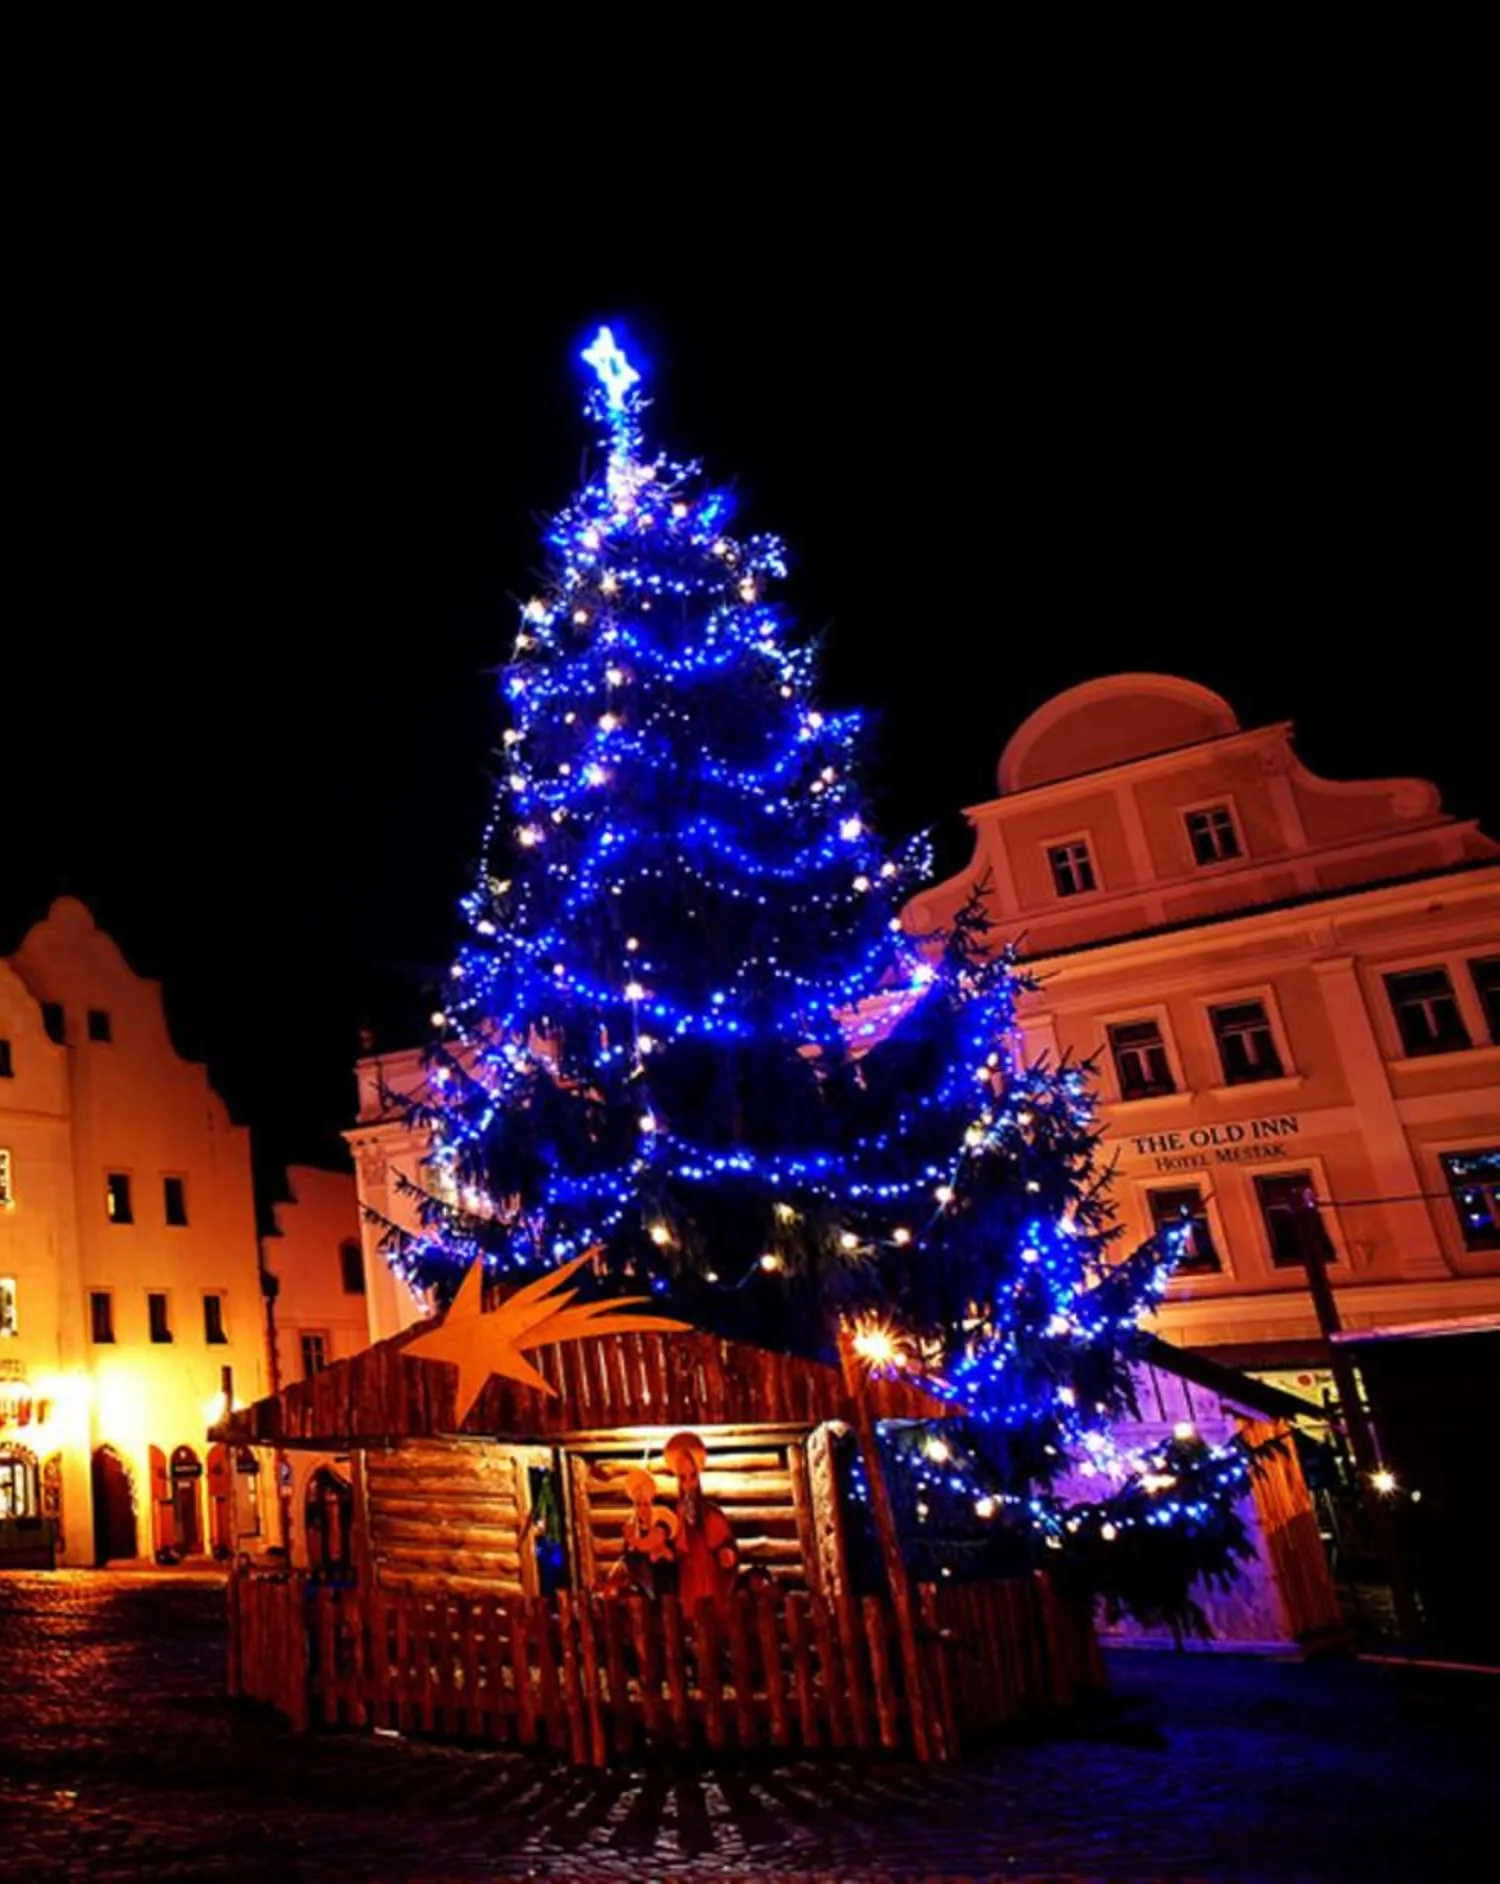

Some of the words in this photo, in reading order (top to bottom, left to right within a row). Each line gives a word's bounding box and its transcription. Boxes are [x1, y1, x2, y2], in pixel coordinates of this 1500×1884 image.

[1131, 1133, 1185, 1154] THE
[1189, 1124, 1245, 1147] OLD
[1251, 1116, 1299, 1139] INN
